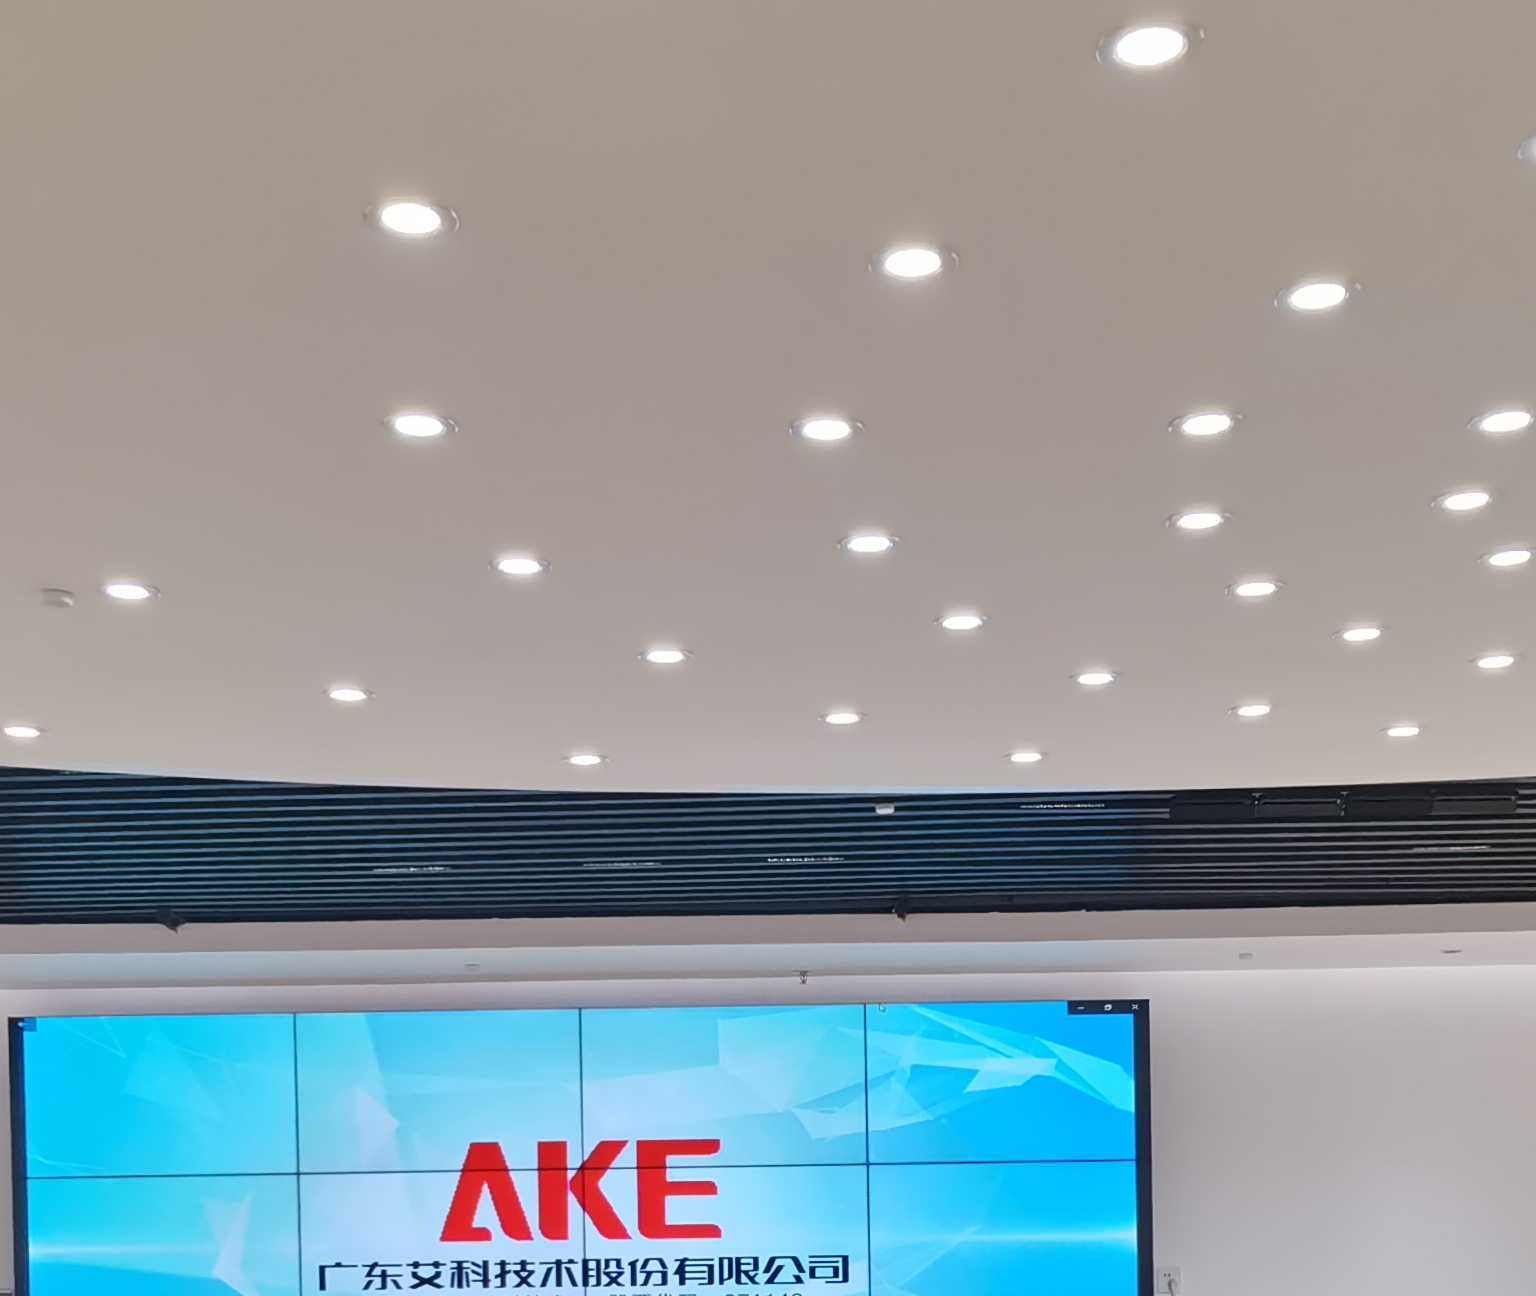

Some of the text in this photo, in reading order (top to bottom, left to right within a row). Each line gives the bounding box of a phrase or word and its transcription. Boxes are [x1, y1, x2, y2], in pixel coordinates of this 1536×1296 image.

[439, 1138, 723, 1242] AKE
[318, 1254, 851, 1292] 广东艾科技术股份有限公司
